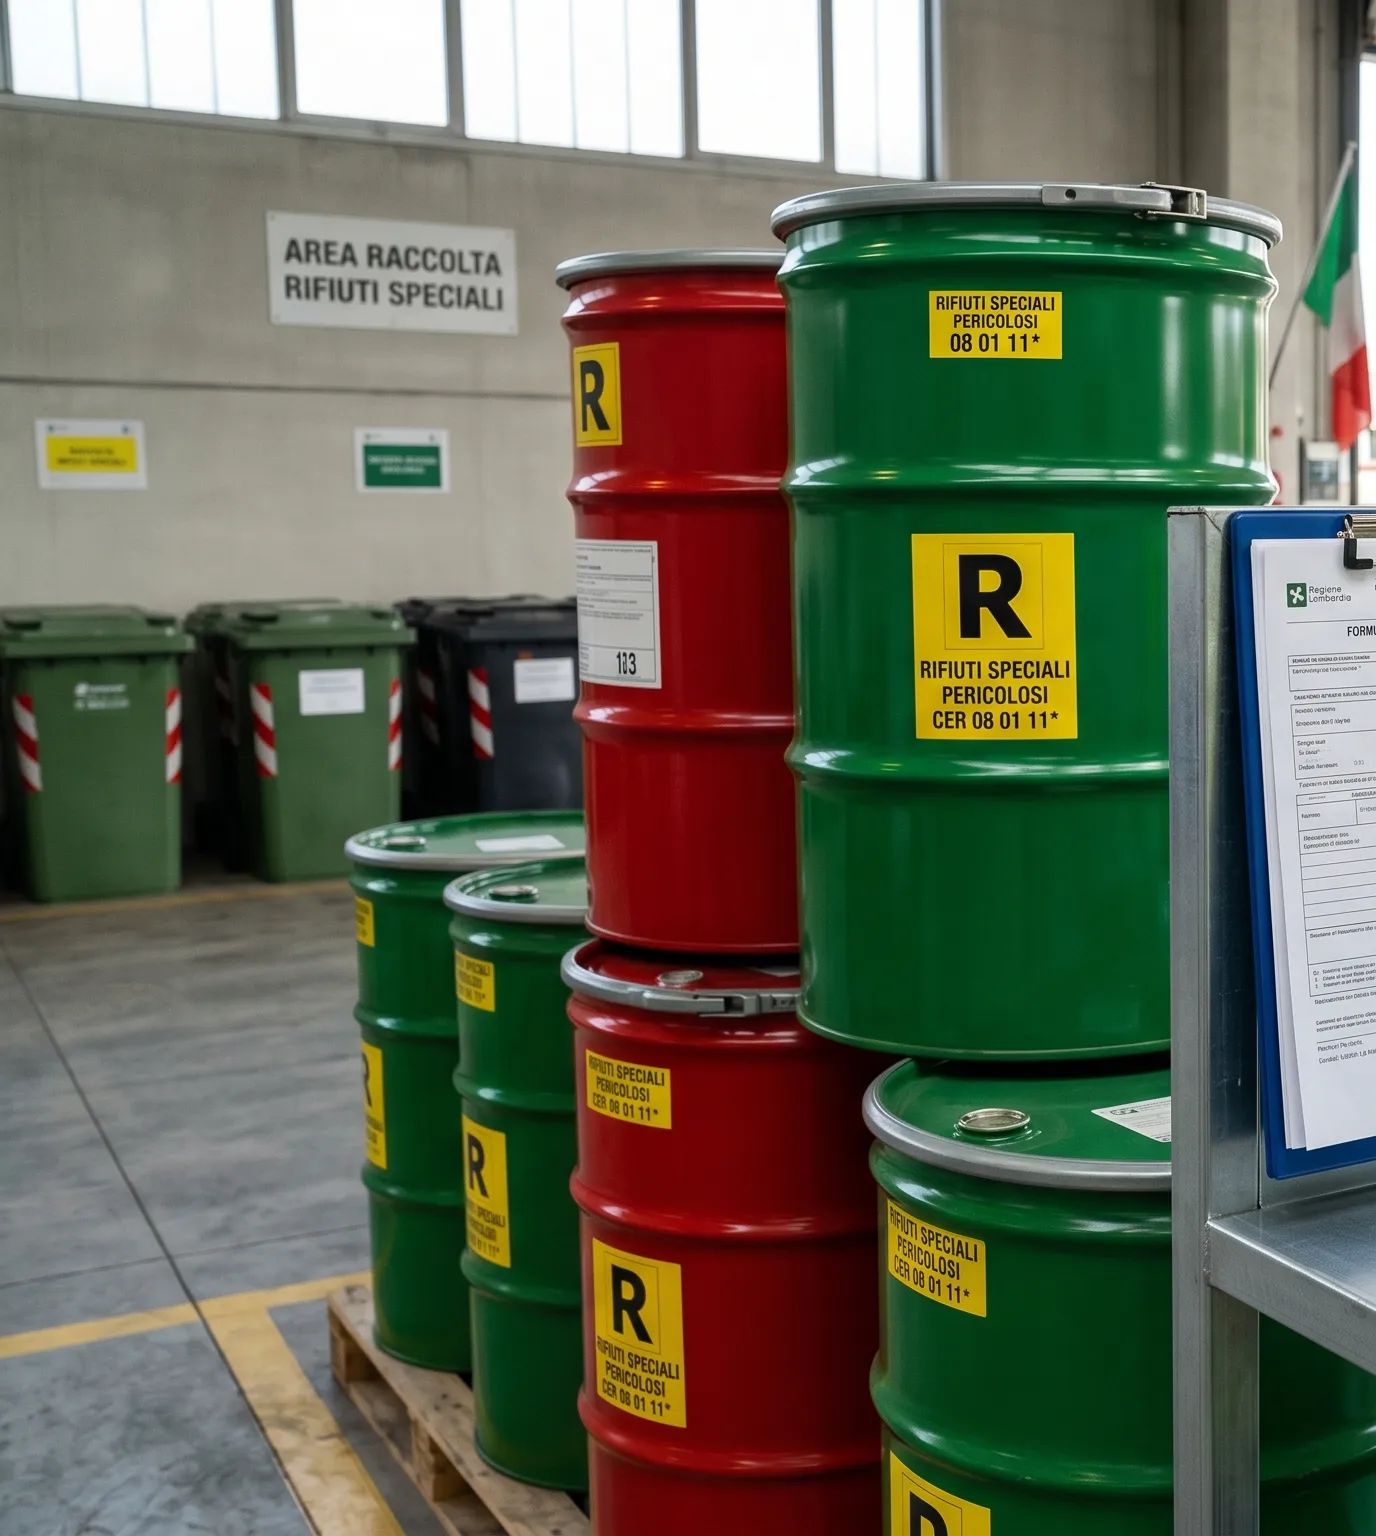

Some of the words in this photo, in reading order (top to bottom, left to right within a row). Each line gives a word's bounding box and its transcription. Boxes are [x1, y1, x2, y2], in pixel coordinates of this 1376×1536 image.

[284, 237, 358, 268] AREA
[366, 243, 502, 277] RACCOLTA
[284, 274, 379, 304] RIFIUTI
[388, 280, 505, 311] SPECIALI
[936, 296, 985, 310] RIFIUTI
[990, 296, 1055, 311] SPECIALI
[953, 314, 1038, 329] PERICOLOSI
[950, 333, 972, 352] 08
[978, 333, 999, 352] 01
[580, 359, 611, 432] R
[958, 554, 1033, 638] R
[920, 661, 981, 679] RIFIUTI
[988, 661, 1070, 679] SPECIALI
[942, 686, 1048, 704] PERICOLOSI
[933, 711, 966, 729] CER
[972, 711, 994, 729] 08
[1000, 711, 1019, 729] 01
[596, 1076, 650, 1102] PERICOLOSI
[617, 1065, 665, 1086] SPECIALI
[623, 1103, 634, 1118] 01
[467, 1132, 489, 1199] R
[889, 1206, 918, 1240] RIFIUTI
[920, 1226, 978, 1262] SPECIALI
[897, 1235, 960, 1280] PERICOLOSI
[894, 1254, 910, 1281] CER
[928, 1275, 941, 1297] 01
[611, 1263, 654, 1345] R
[605, 1360, 666, 1397] PERICOLOSI
[627, 1351, 680, 1380] SPECIALI
[602, 1379, 618, 1401] CER
[633, 1395, 646, 1412] 01
